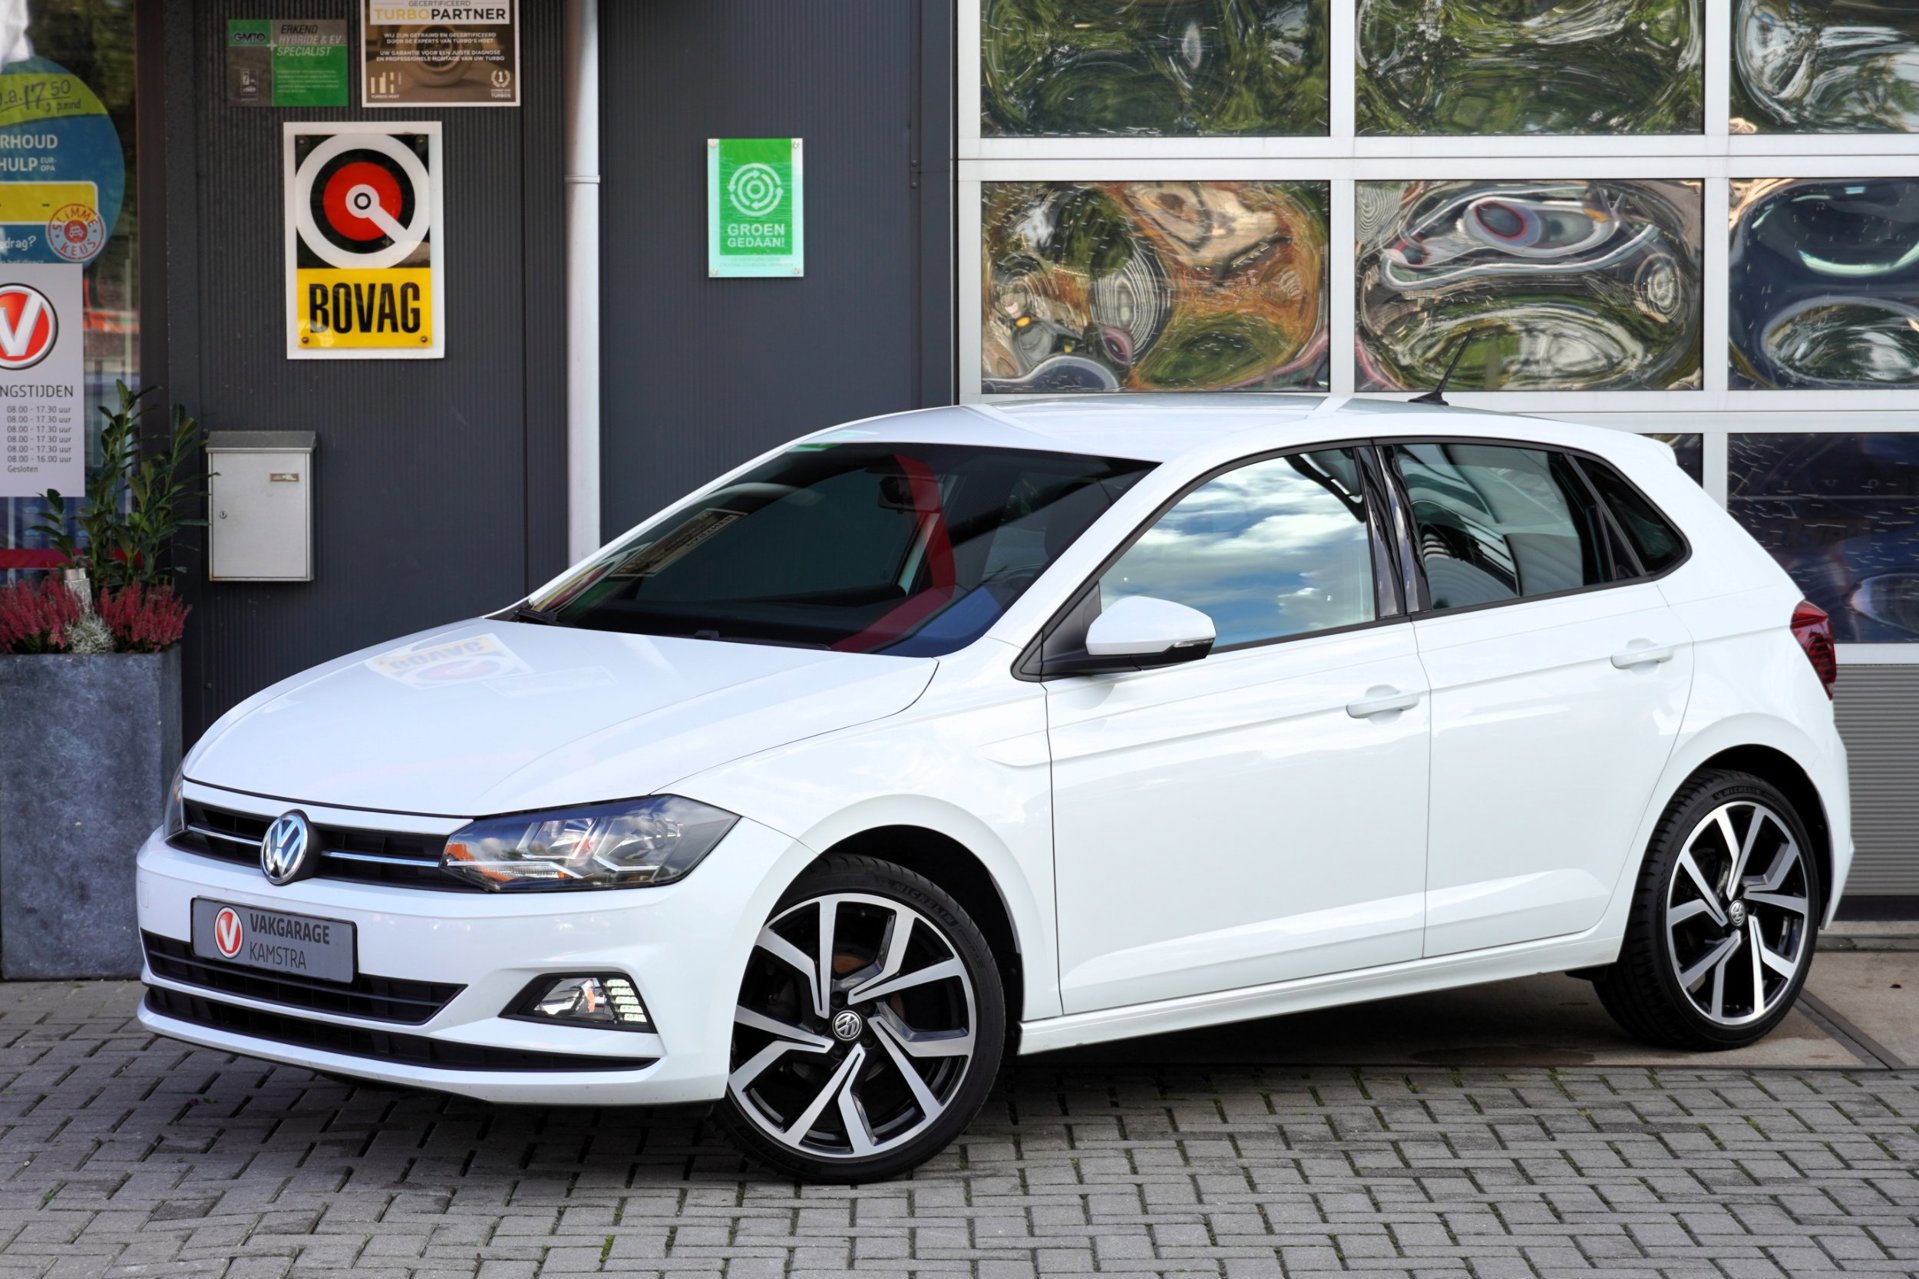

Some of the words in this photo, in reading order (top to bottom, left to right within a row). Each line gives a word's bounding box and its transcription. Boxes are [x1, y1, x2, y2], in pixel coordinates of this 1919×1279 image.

[374, 8, 506, 20] TURBOPARTNER
[281, 24, 318, 34] ERKEND
[279, 35, 317, 44] HYBRIDE
[330, 35, 342, 44] EV
[277, 47, 331, 56] SPECIALIST
[728, 224, 785, 236] GROEN
[728, 238, 785, 248] GEDAAN!
[309, 282, 420, 334] BOVAG
[0, 384, 73, 398] NGSTIJDEN
[250, 913, 331, 944] VAKGARAGE
[250, 941, 307, 969] KAMSTRA
